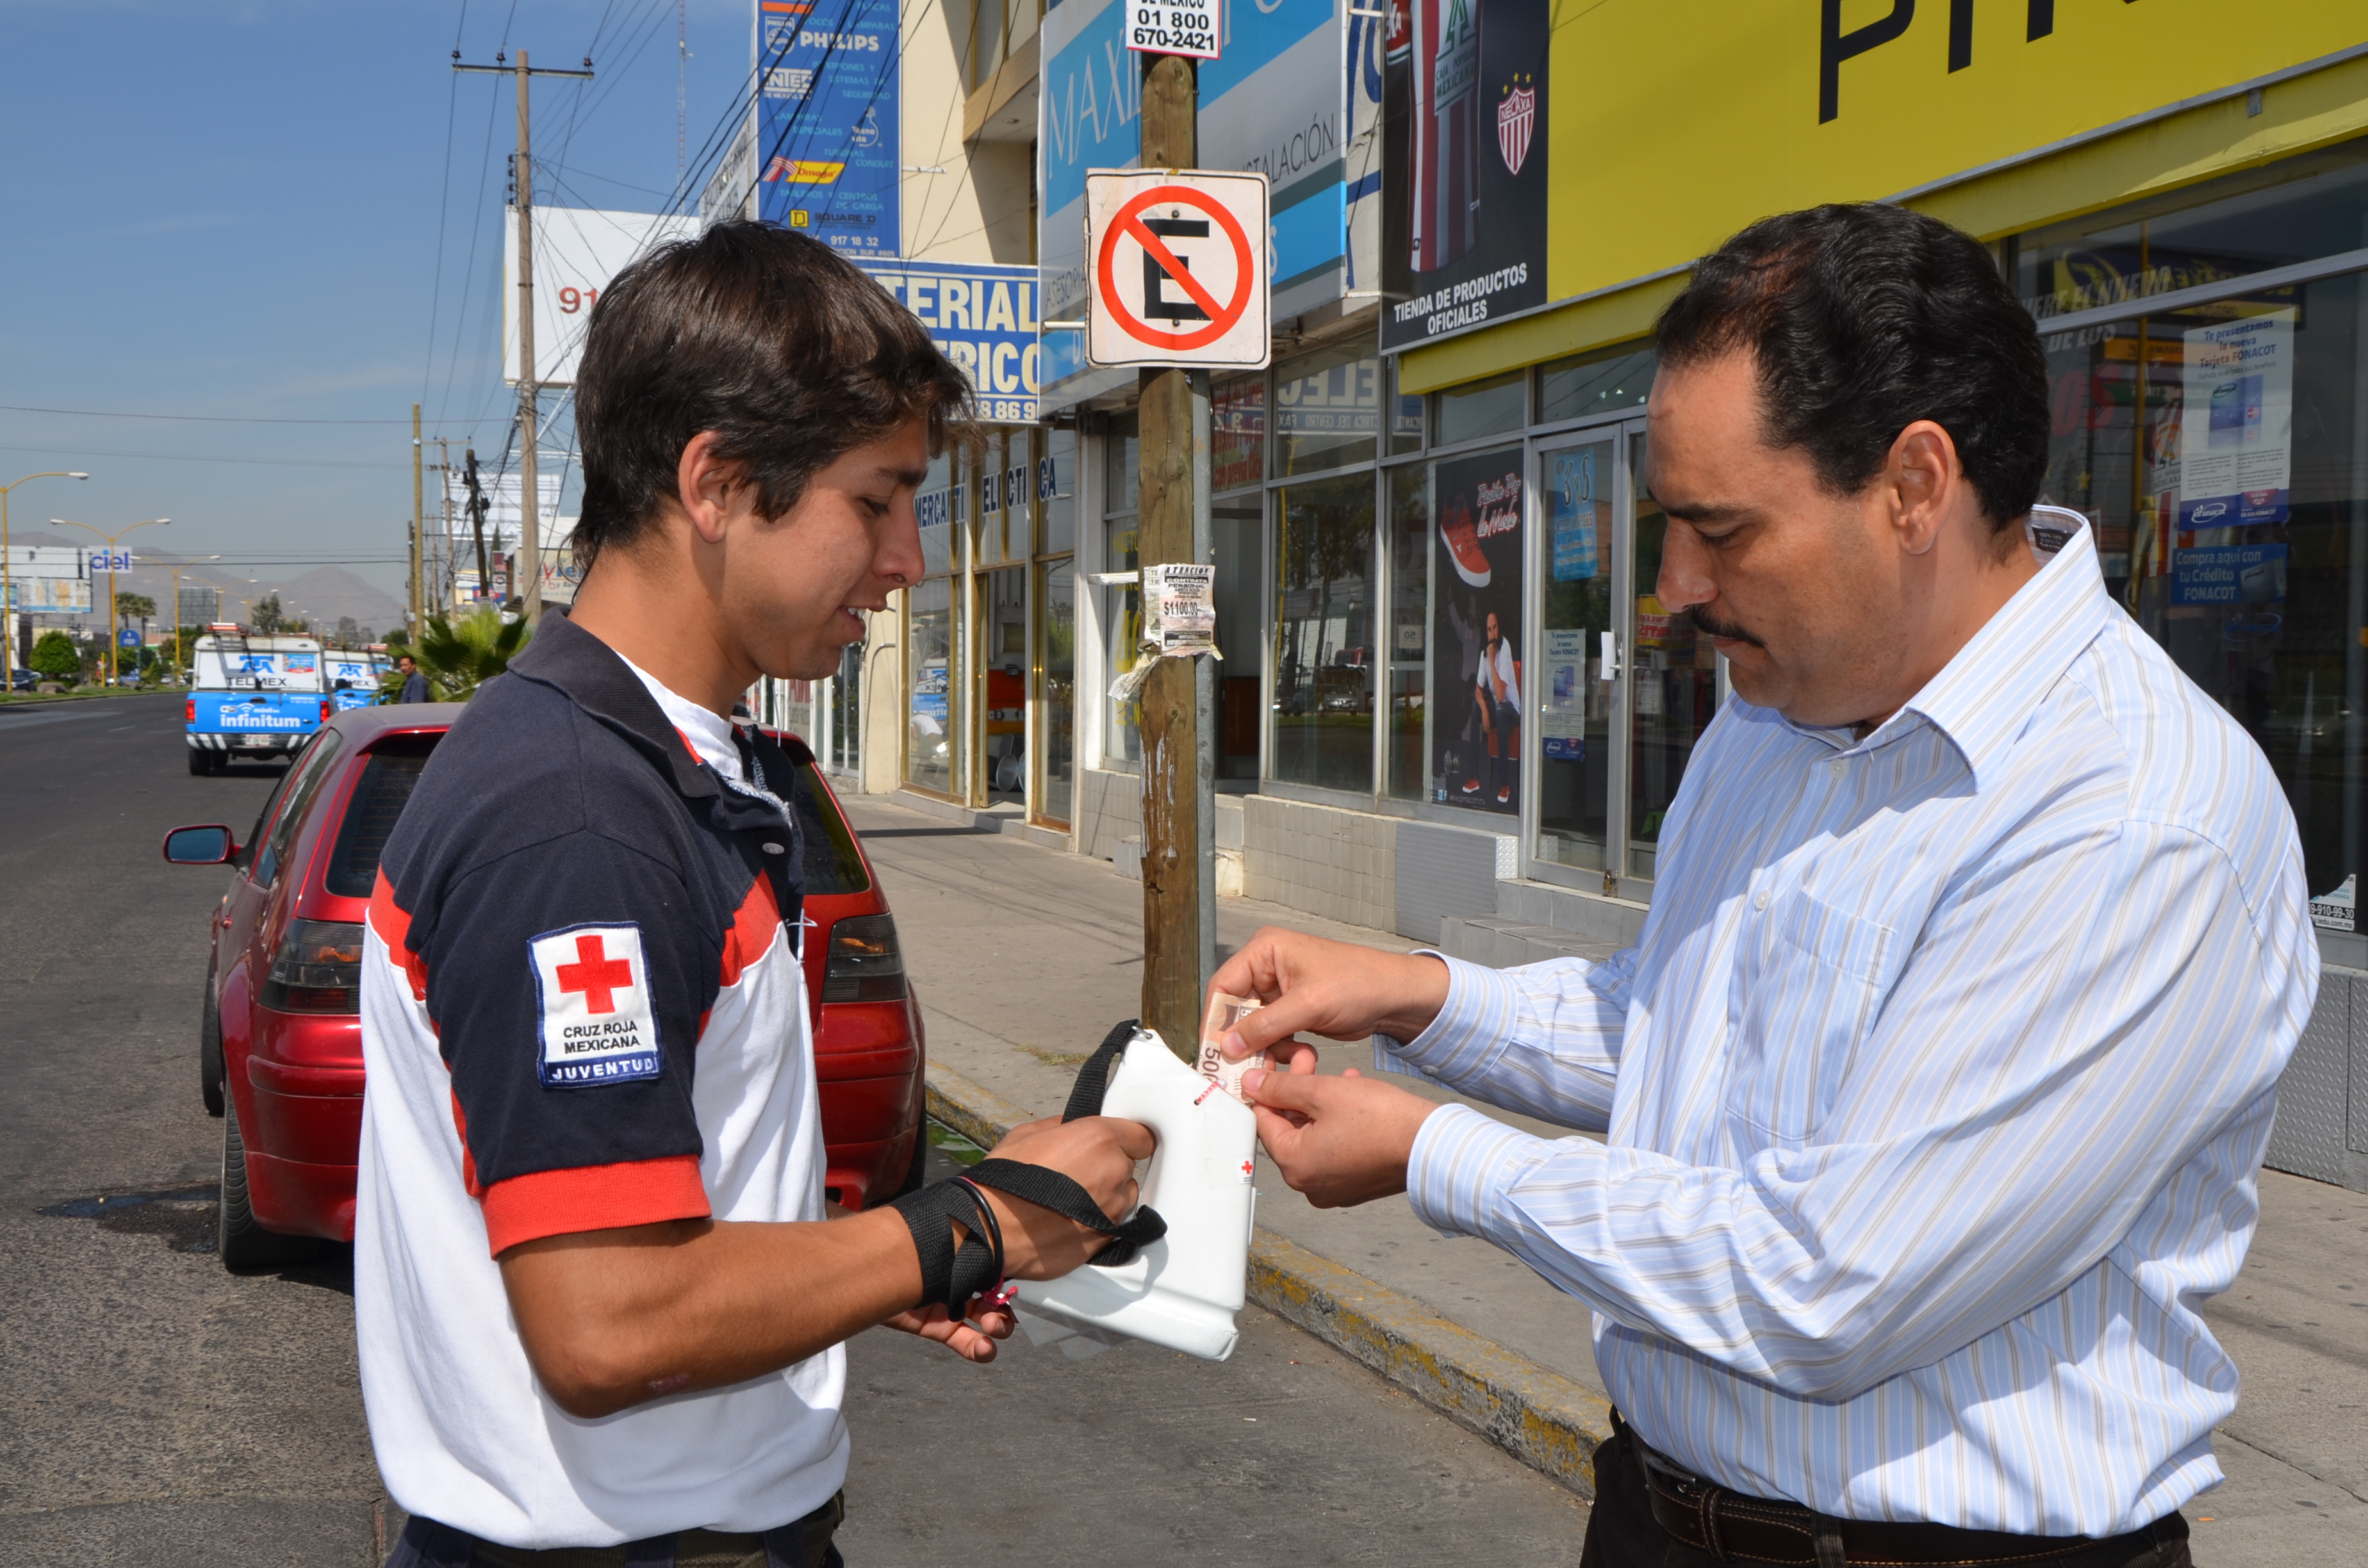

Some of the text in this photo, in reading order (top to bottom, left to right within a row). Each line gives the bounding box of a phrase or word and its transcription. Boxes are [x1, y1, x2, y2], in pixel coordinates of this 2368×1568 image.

[1138, 9, 1209, 29] 01 800
[800, 31, 880, 51] PHILIPS
[1134, 27, 1214, 51] 670-2421
[1501, 95, 1531, 122] NECAXA
[798, 168, 834, 178] Omega
[855, 159, 894, 168] CONDUIT
[852, 202, 884, 211] CARGA
[830, 235, 879, 247] 917 18 32
[1142, 218, 1211, 320] E
[1394, 262, 1527, 323] TIENDA DE PRODUCTOS
[1427, 299, 1488, 335] OFICIALES
[2205, 320, 2274, 342] Te presentamos
[2219, 337, 2257, 351] la nueva
[2199, 343, 2277, 369] Tarjeta FONACOT
[933, 339, 1038, 395] RICO
[2048, 363, 2121, 436] OS
[995, 400, 1021, 420] 86
[91, 549, 129, 571] ciel
[2176, 548, 2261, 566] Compra aquí con
[2180, 568, 2235, 583] tu Crédito
[2184, 586, 2236, 601] FONACOT
[1164, 601, 1198, 616] $1100.00
[226, 677, 287, 687] TELMEX
[220, 713, 301, 728] infinitum
[563, 1020, 638, 1038] CRUZ ROJA
[564, 1035, 641, 1054] MEXICANA
[552, 1058, 654, 1081] JUVENTUD
